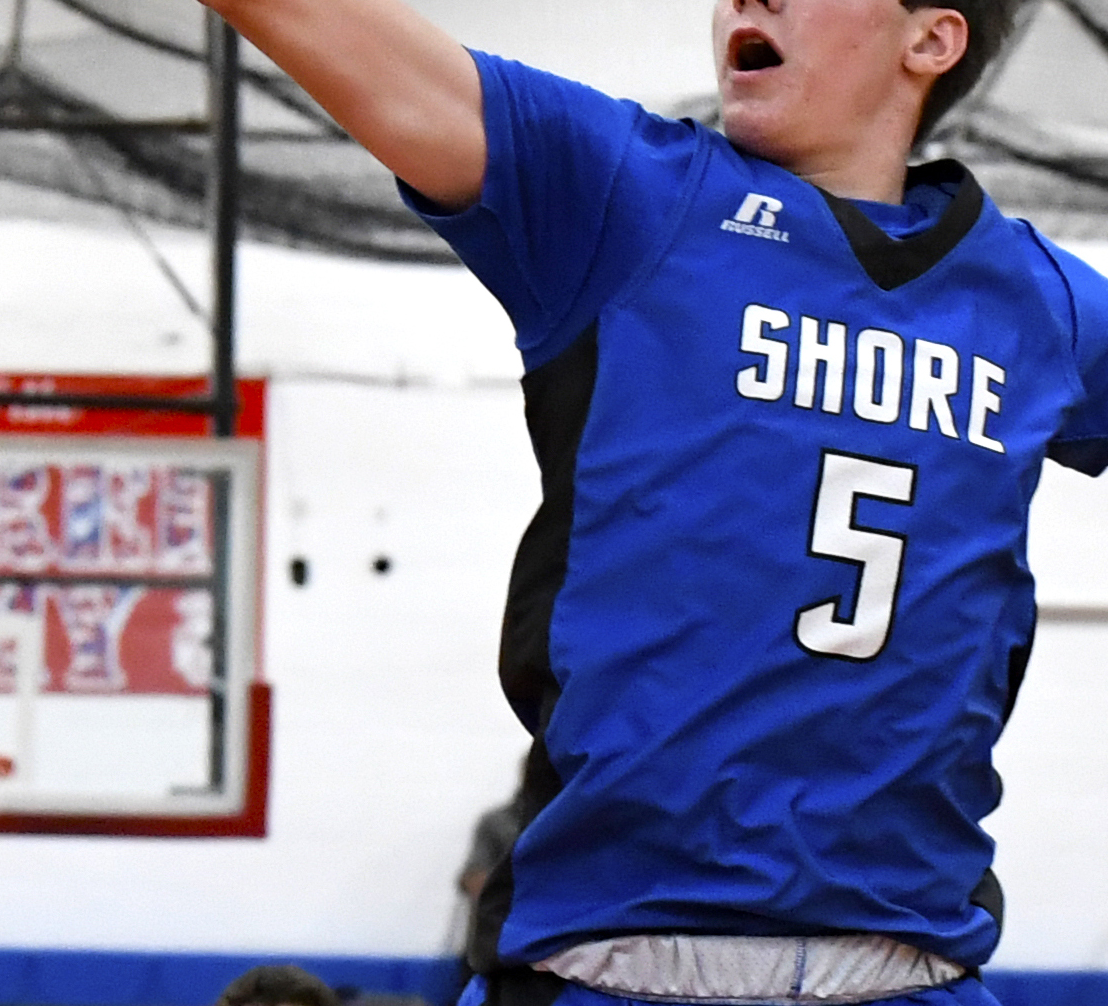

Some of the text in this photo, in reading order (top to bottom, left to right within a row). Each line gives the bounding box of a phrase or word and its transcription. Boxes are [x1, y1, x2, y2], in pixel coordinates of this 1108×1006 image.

[719, 218, 790, 244] RUSSELL
[736, 302, 1007, 455] SHORE
[794, 447, 919, 663] 5
